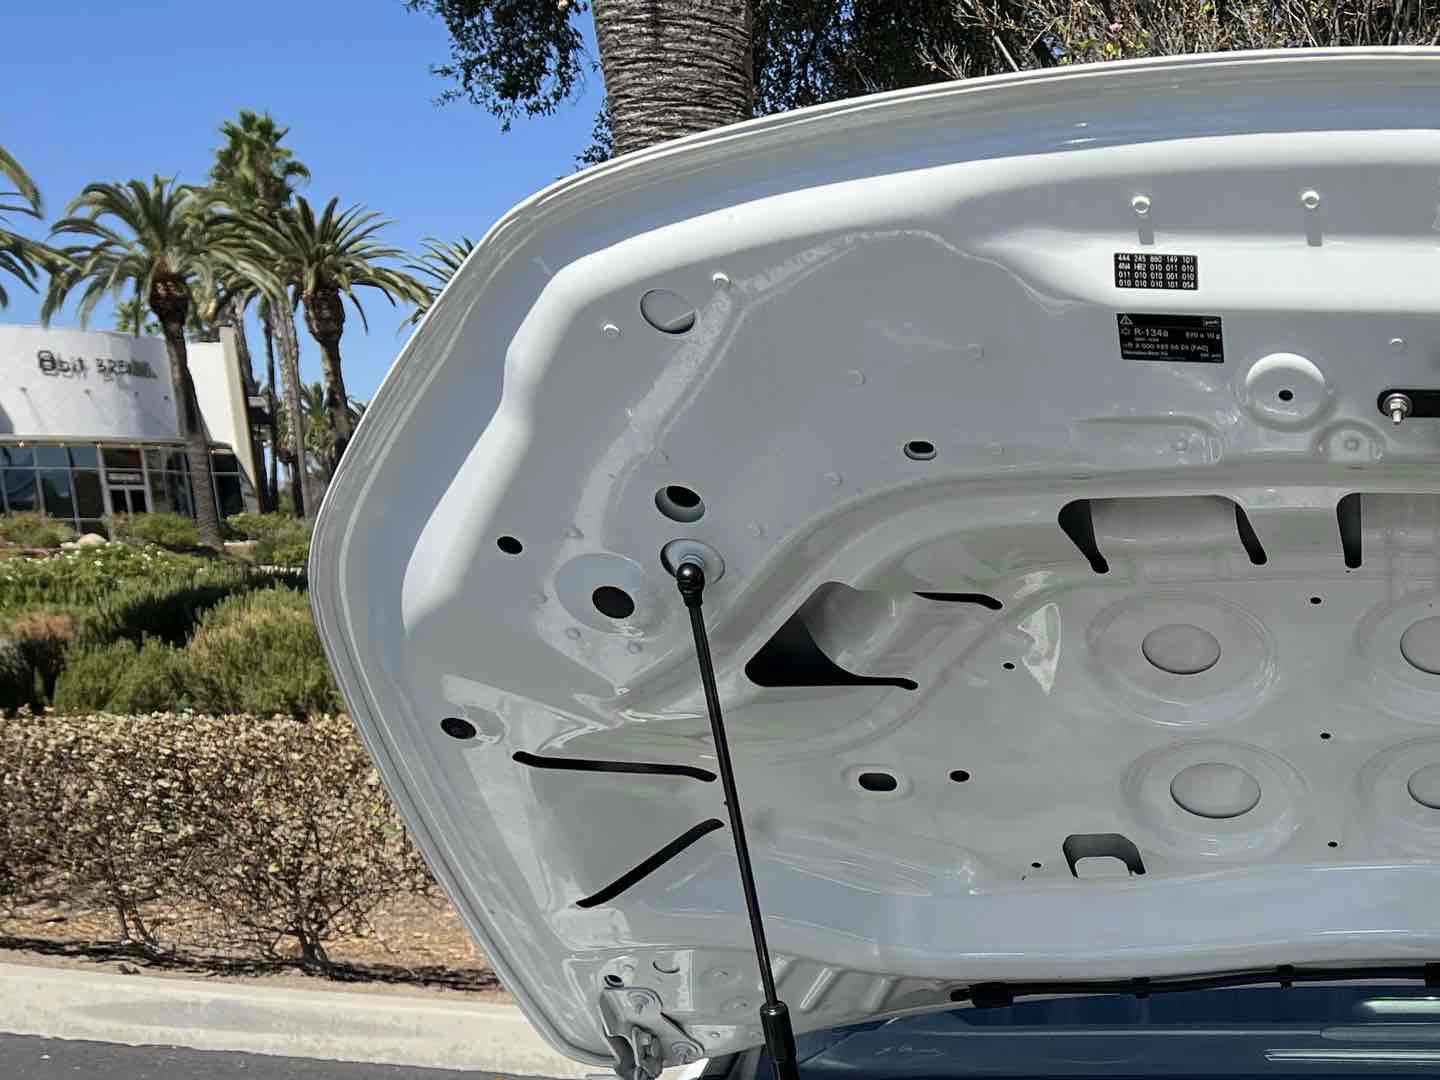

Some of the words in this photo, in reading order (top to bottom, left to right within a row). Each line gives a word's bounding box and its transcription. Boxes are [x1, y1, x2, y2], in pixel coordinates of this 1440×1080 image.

[1150, 263, 1162, 271] 010
[1181, 264, 1194, 272] 010
[1134, 271, 1147, 279] 010
[1166, 272, 1178, 280] 001
[1181, 273, 1194, 281] 010
[1118, 279, 1131, 287] 010
[1133, 327, 1169, 337] R-134a
